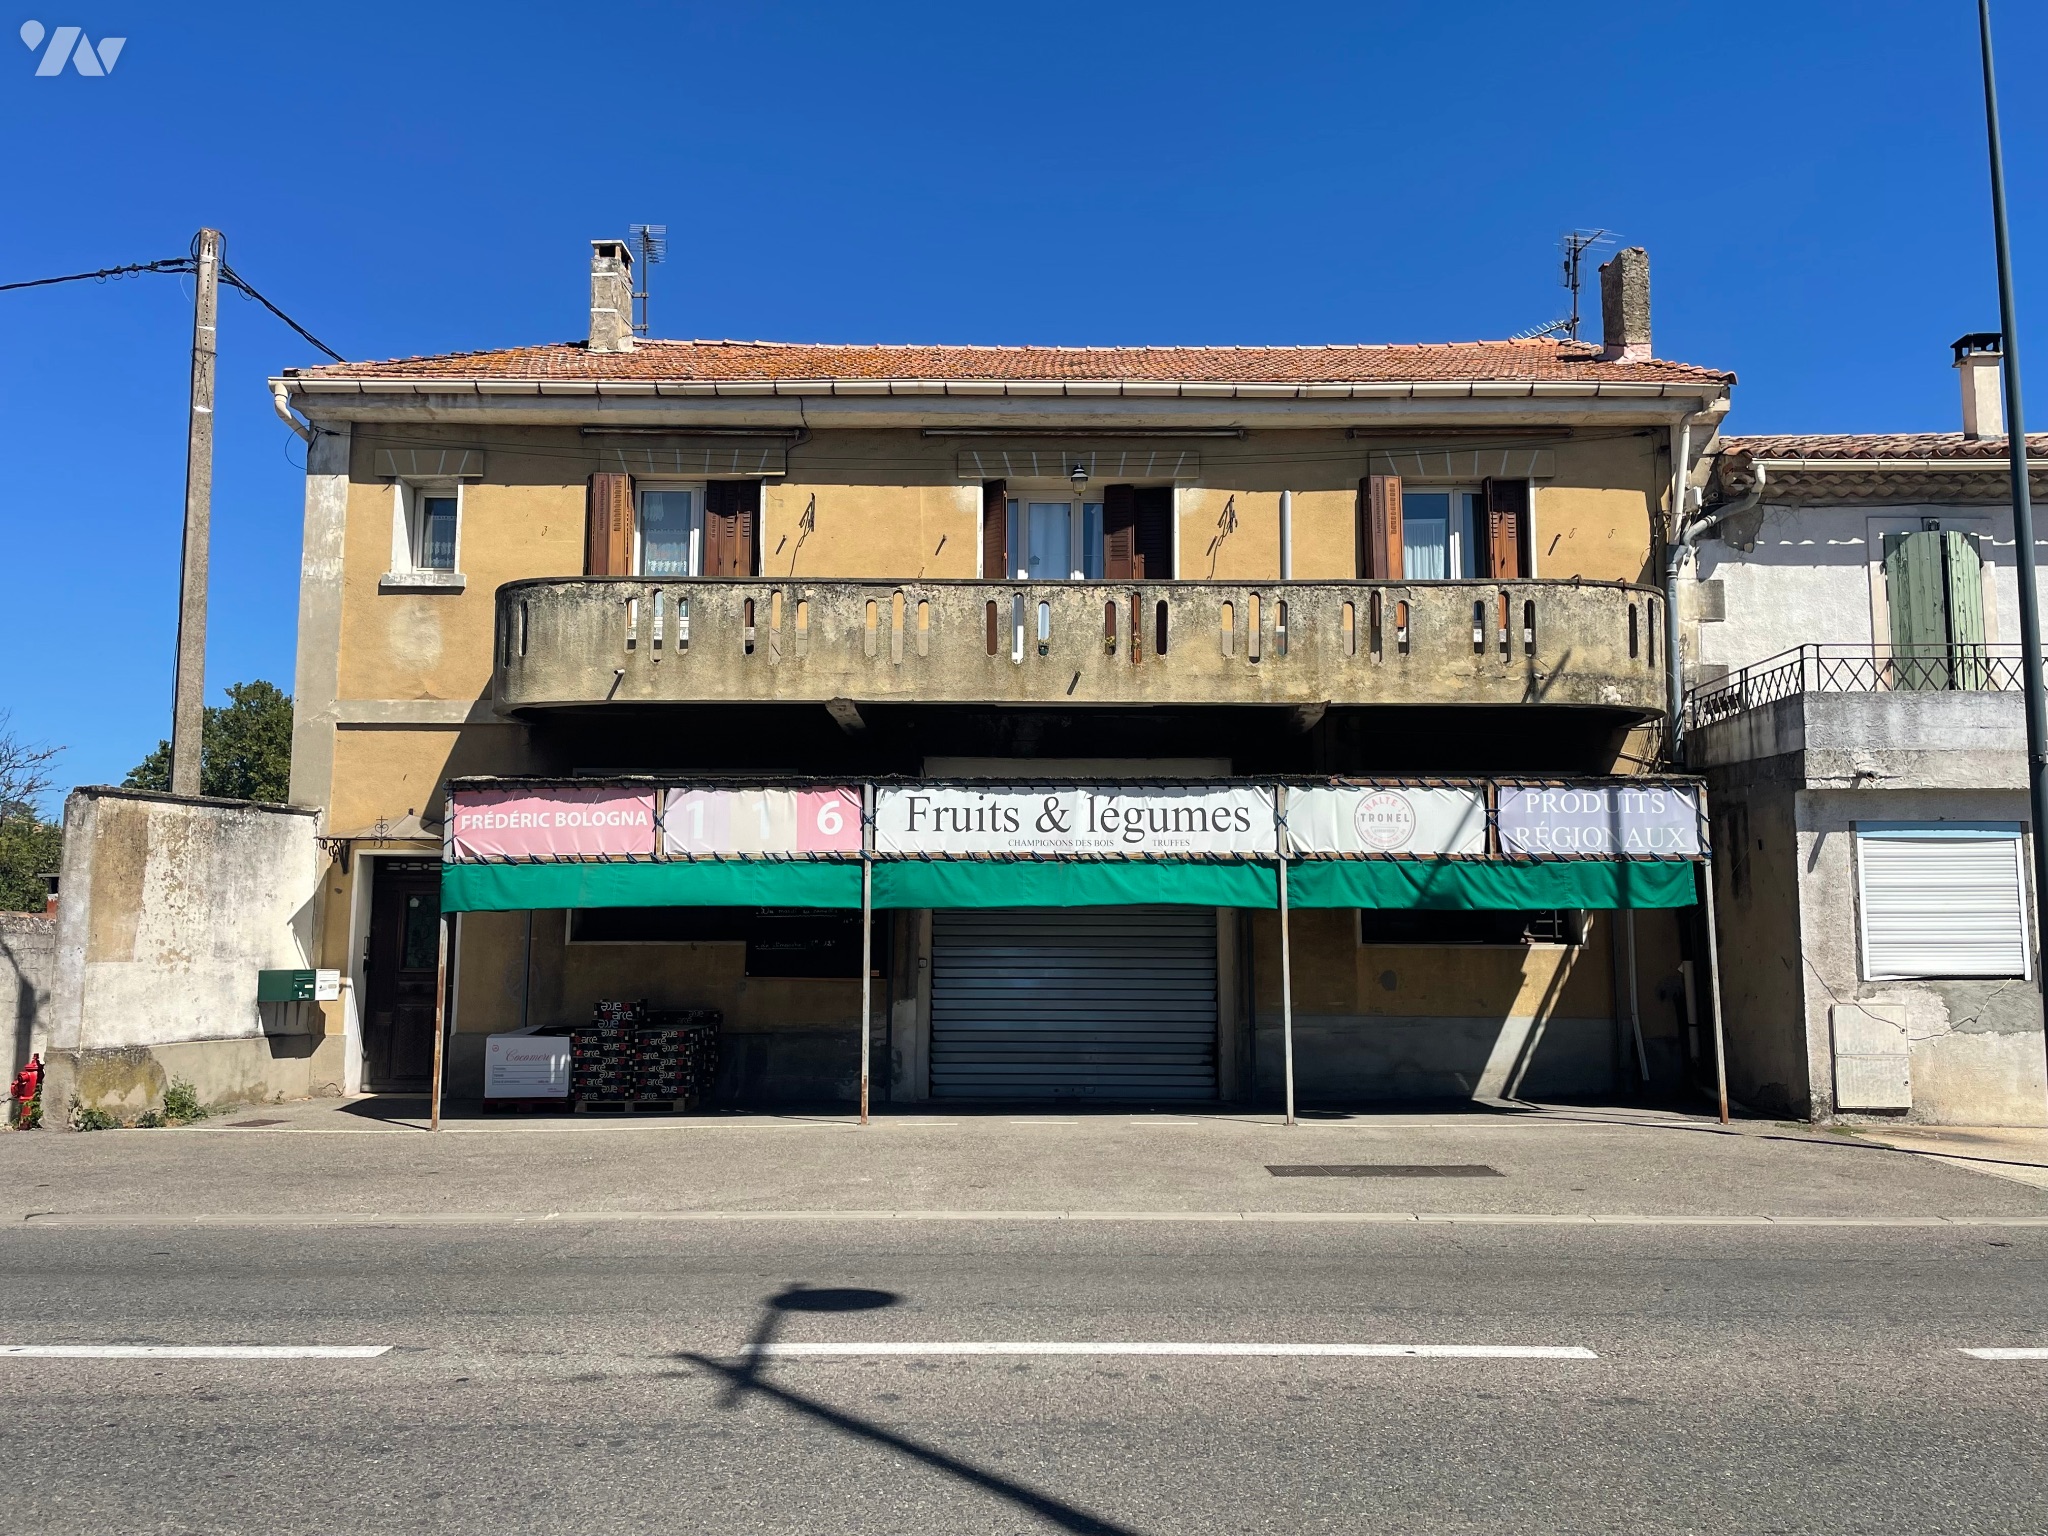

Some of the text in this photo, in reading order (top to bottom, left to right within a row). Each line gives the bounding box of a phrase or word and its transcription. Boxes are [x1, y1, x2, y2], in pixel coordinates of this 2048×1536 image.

[1364, 796, 1398, 811] HALTE
[1525, 793, 1665, 814] PRODUITS
[461, 810, 648, 830] FRÉDÉRIC BOLOGNA
[686, 800, 844, 840] 1 1 6
[905, 795, 1251, 844] Fruits & légumes
[1360, 813, 1410, 822] TRONEL
[1008, 839, 1191, 847] CHAMPIGNONS DES BOIS TRUFFES
[1516, 821, 1688, 848] RÉGIONAUX
